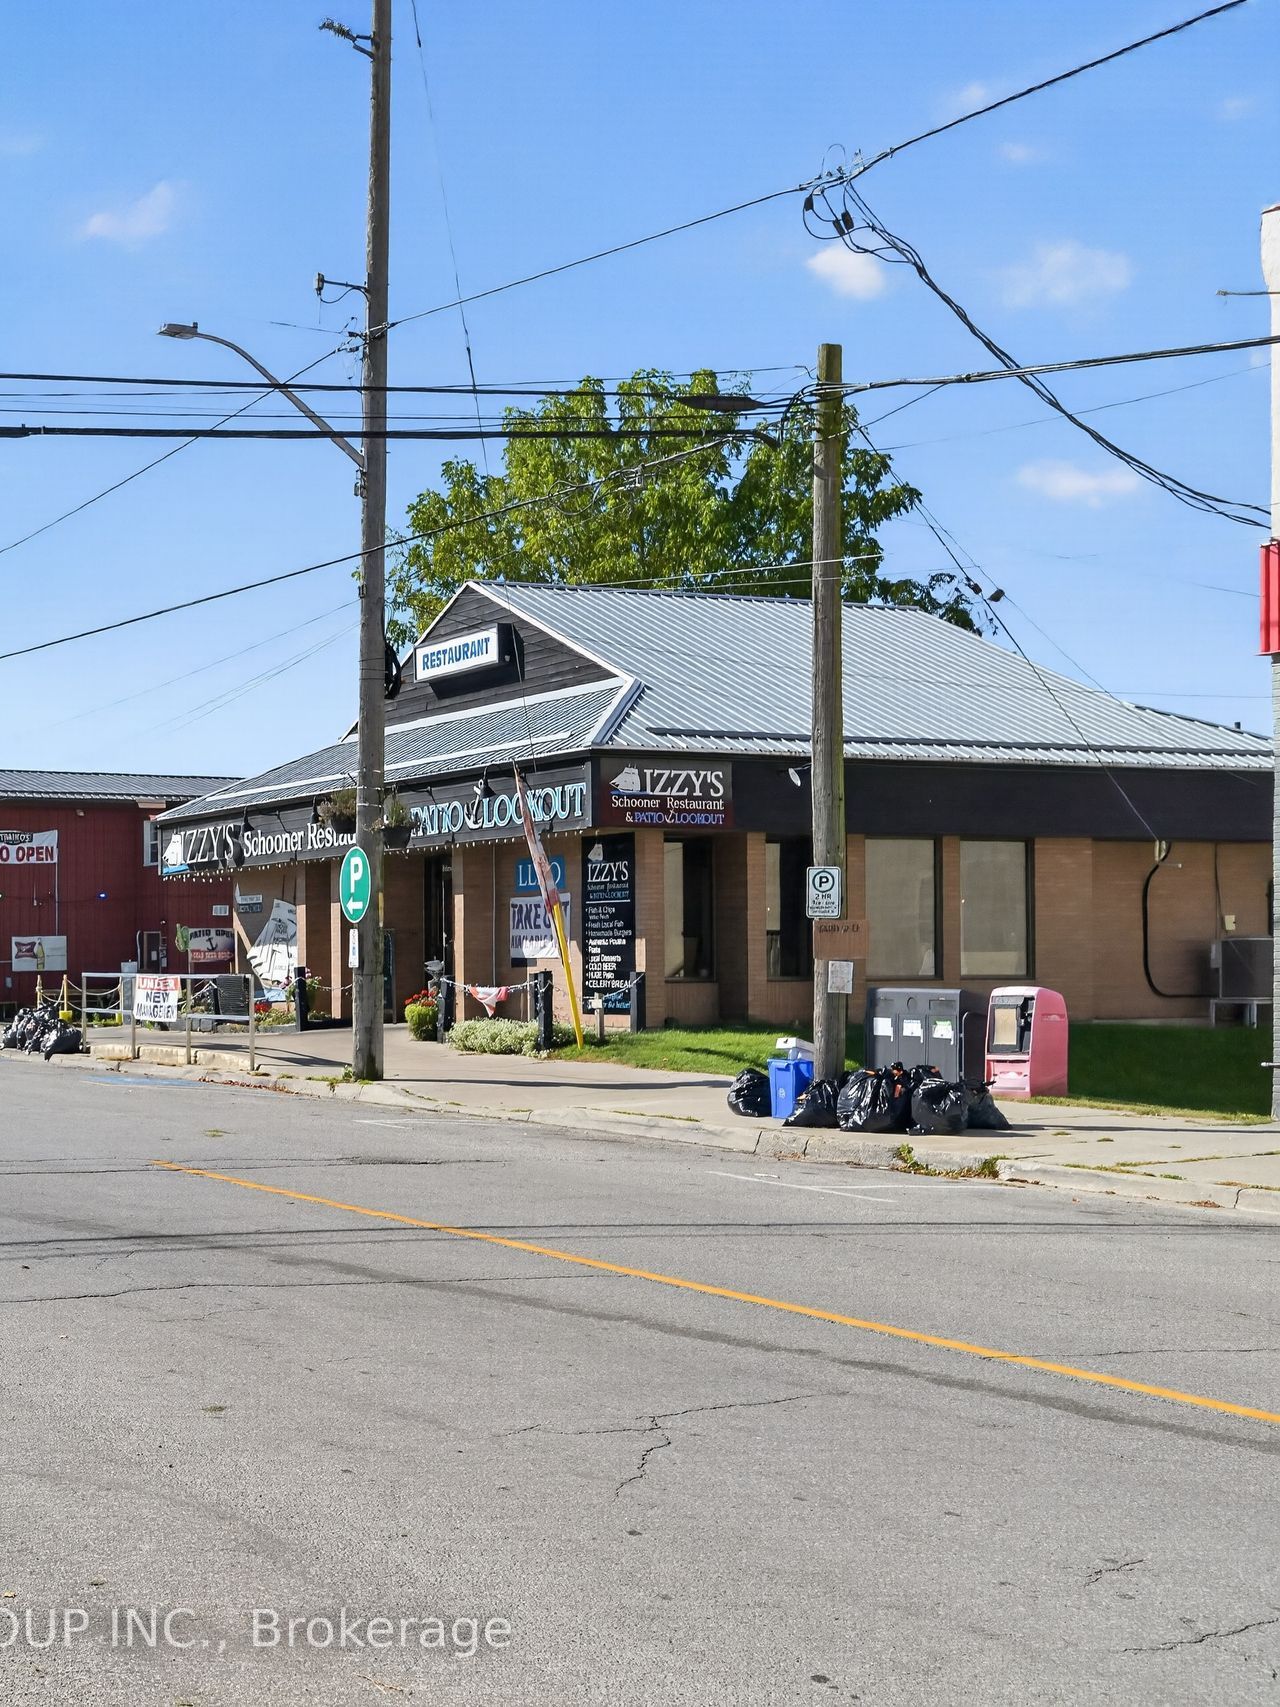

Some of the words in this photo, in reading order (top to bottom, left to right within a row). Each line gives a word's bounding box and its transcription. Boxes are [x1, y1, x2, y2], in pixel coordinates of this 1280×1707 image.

[422, 636, 490, 671] RESTAURANT
[643, 769, 724, 797] IZZY'S
[611, 795, 661, 808] Schooner
[666, 797, 725, 810] Restaurant
[181, 824, 235, 864] IZZY'S
[243, 829, 305, 858] Schooner
[306, 822, 357, 850] Restau
[410, 801, 464, 837] PATIO
[482, 782, 587, 828] LOOKOUT
[625, 811, 634, 822] &
[634, 812, 665, 824] PATIO
[675, 813, 725, 824] LOOKOUT
[15, 845, 54, 862] OPEN
[350, 856, 363, 893] P
[518, 861, 561, 887] LLO
[587, 860, 629, 882] IZZY'S
[819, 876, 829, 888] P
[511, 903, 541, 930] TAKE
[543, 901, 570, 929] OT
[189, 929, 211, 941] PATIO
[140, 977, 176, 990] UNDER
[146, 991, 170, 1003] NEW
[136, 1002, 175, 1019] MANAGEMEN
